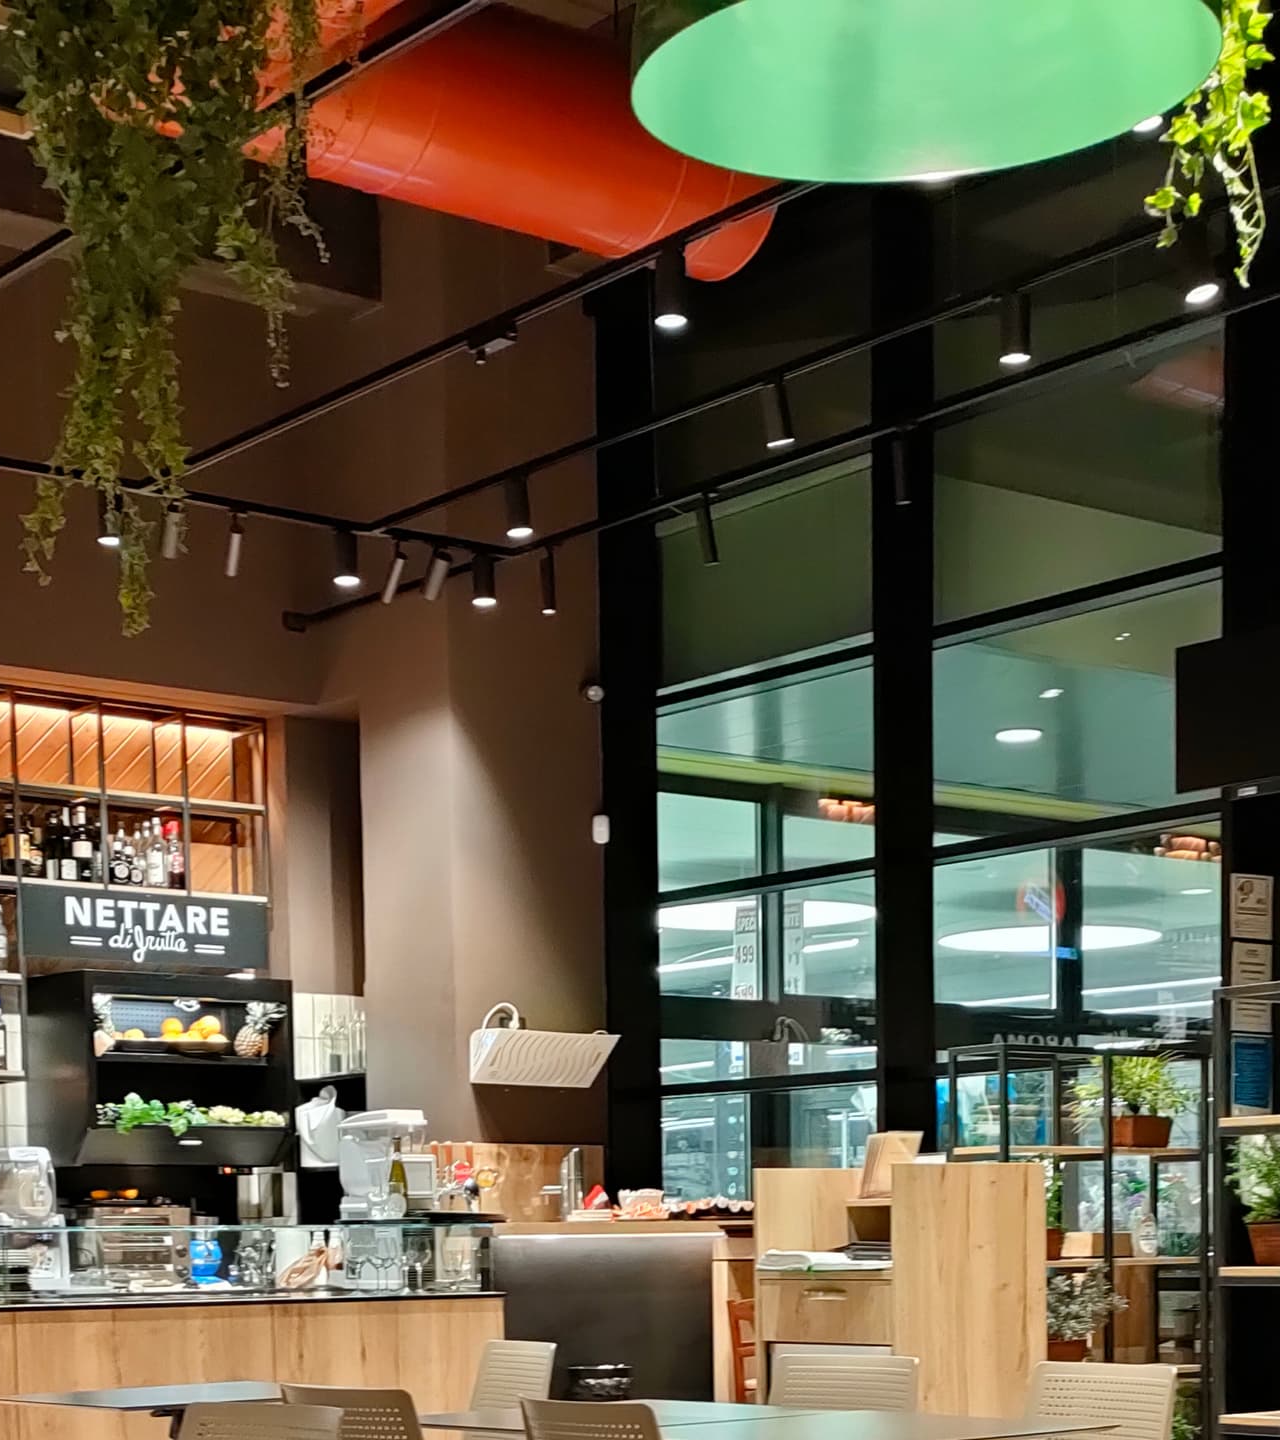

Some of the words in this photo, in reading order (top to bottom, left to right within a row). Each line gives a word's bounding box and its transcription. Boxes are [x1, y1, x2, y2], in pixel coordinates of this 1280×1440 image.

[64, 896, 231, 936] NETTARE
[108, 923, 132, 949] di
[132, 925, 189, 963] frutta
